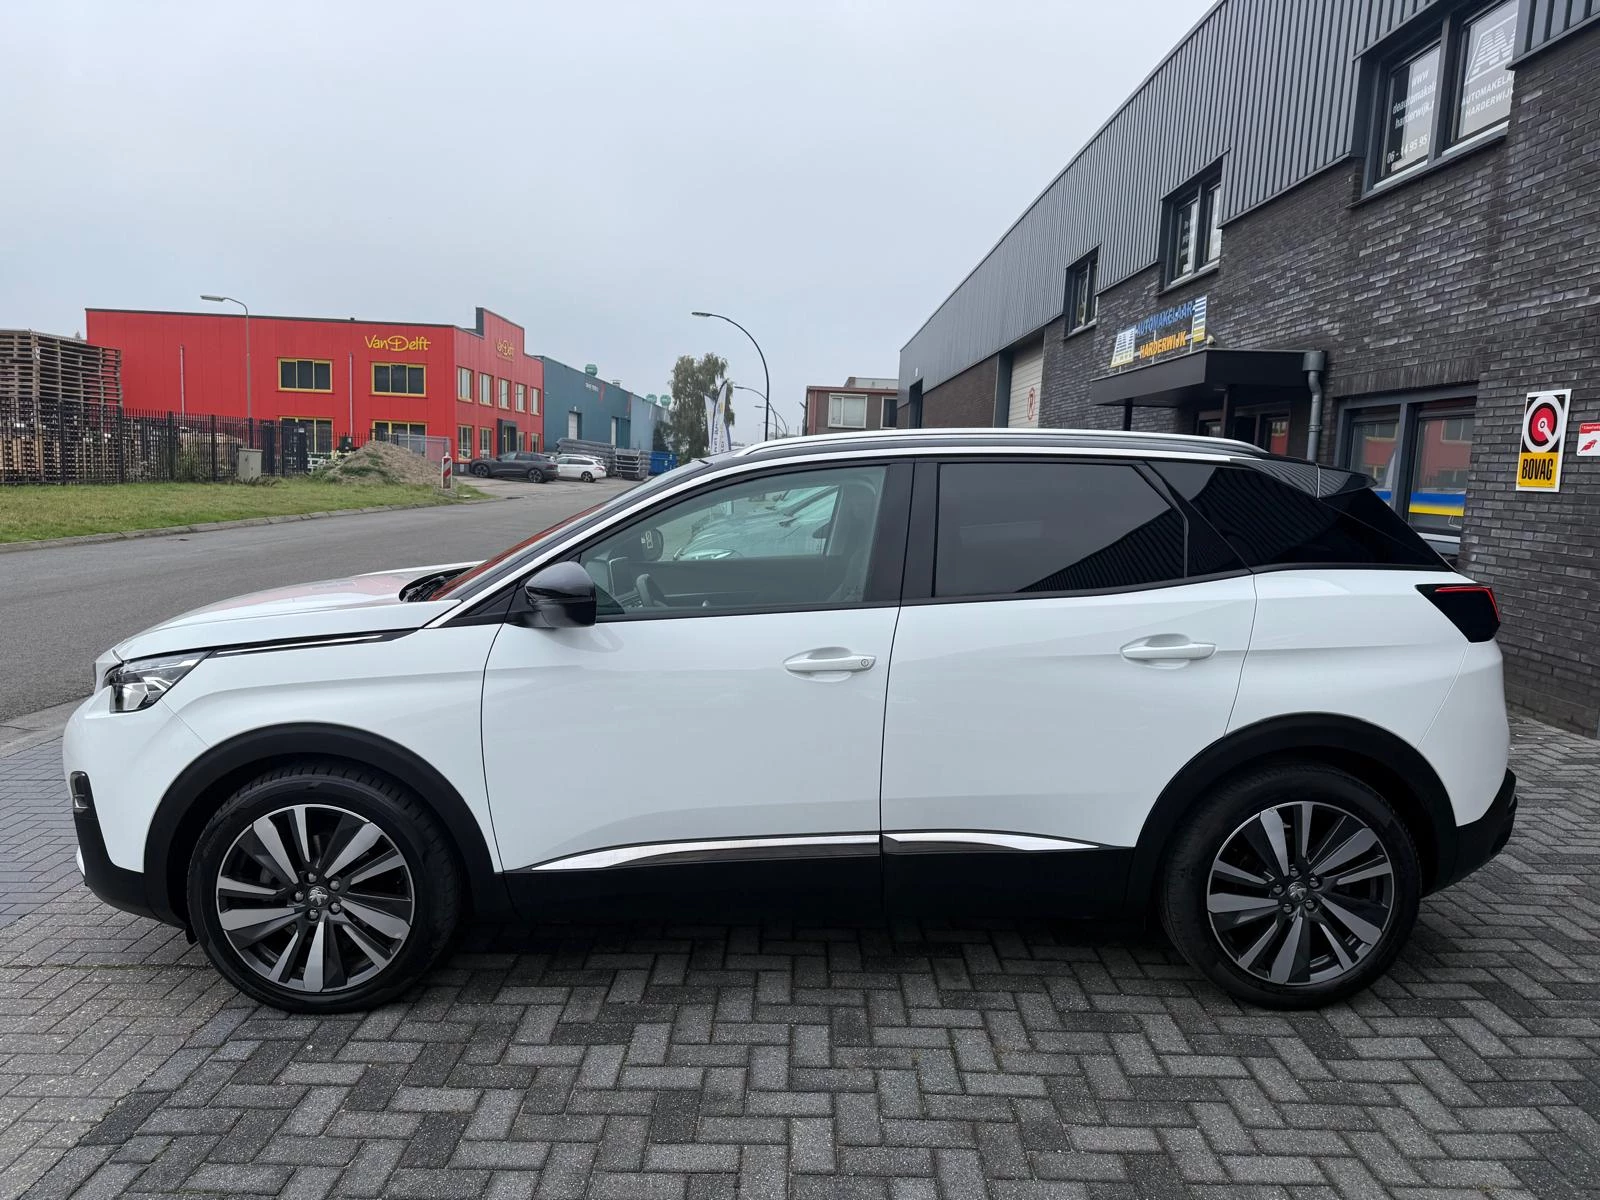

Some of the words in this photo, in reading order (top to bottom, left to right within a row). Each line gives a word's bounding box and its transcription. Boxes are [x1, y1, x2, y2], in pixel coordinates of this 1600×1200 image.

[1137, 300, 1194, 336] AUTOMAKELAAR
[1139, 330, 1187, 359] HARDERWIJK
[1521, 458, 1554, 481] BOVAG
